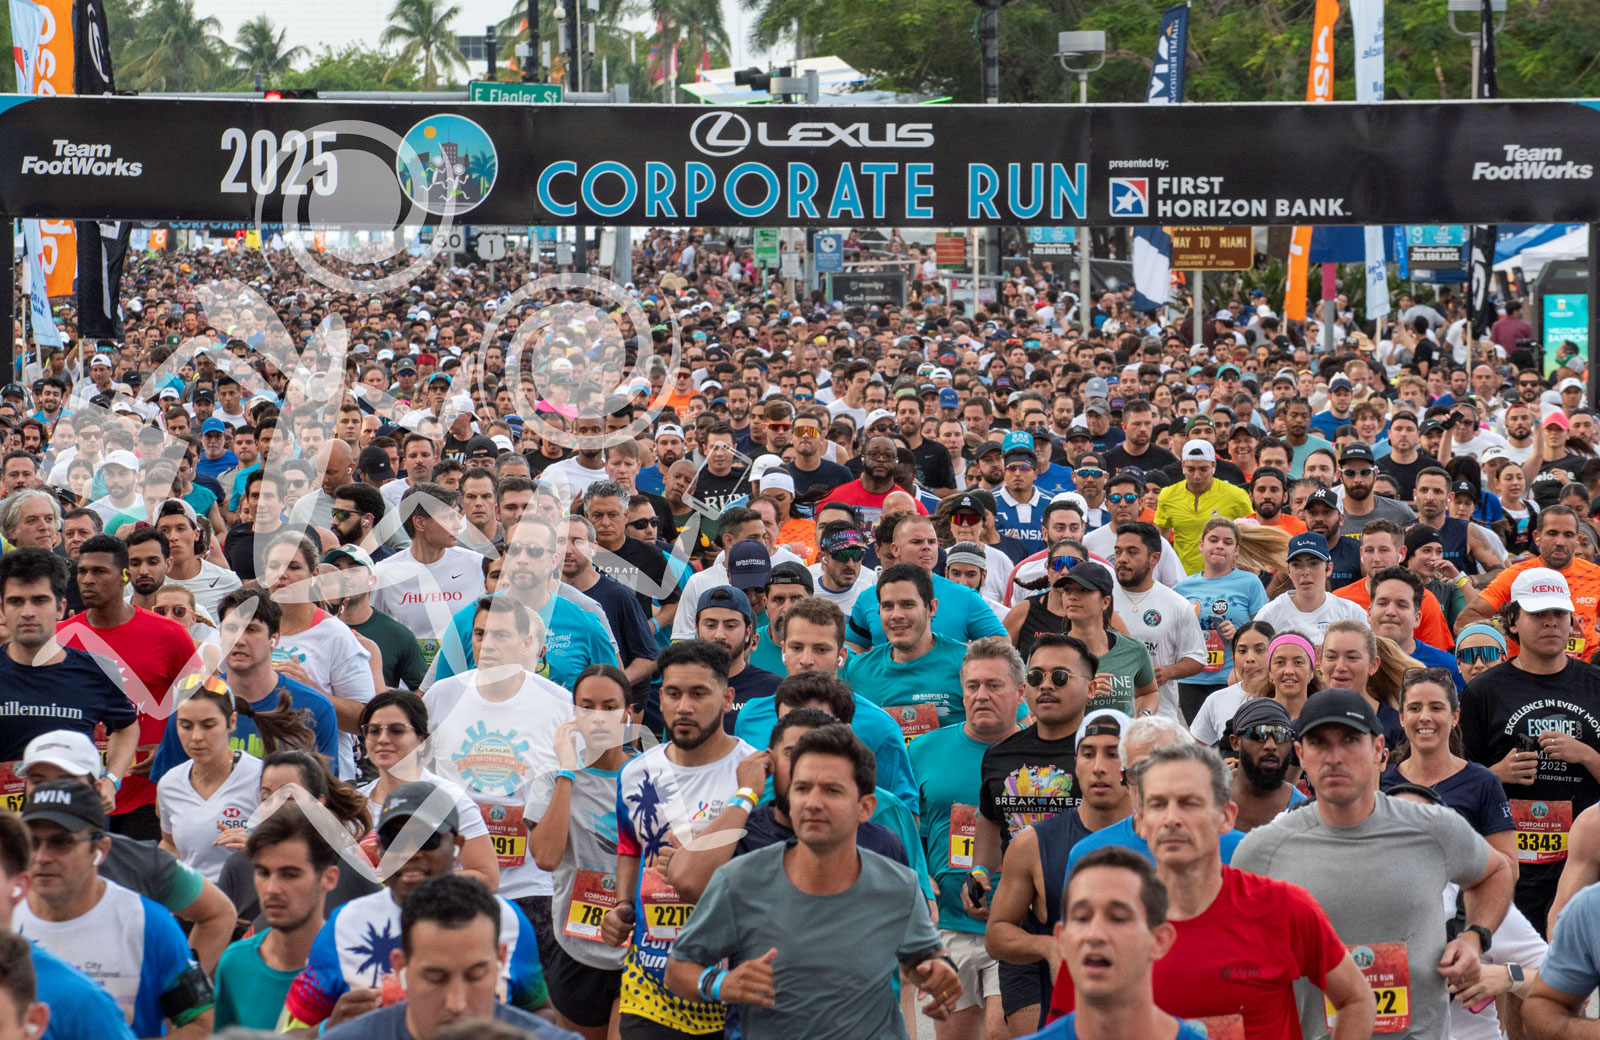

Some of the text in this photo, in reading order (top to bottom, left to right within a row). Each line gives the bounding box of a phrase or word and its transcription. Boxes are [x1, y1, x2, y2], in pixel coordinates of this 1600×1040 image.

[475, 88, 558, 103] E Flagler St
[757, 122, 935, 148] LEXUS
[52, 139, 111, 158] Team
[1503, 144, 1563, 162] Team
[21, 155, 143, 177] FootWorks
[220, 127, 339, 197] 2025
[1109, 159, 1169, 170] presented by:
[1472, 161, 1594, 181] FootWorks
[536, 159, 1089, 220] CORPORATE RUN
[1157, 176, 1224, 195] FIRST
[1157, 198, 1345, 218] HORIZON BANK
[436, 234, 460, 248] 30
[489, 240, 494, 255] 1
[1173, 236, 1247, 248] WAY TO MIAMI
[1532, 584, 1564, 594] KENYA
[397, 591, 462, 606] SHISEIDO
[1213, 602, 1226, 611] 305
[1504, 700, 1544, 736] EXCELLENCE
[1545, 699, 1556, 708] IN
[1557, 700, 1586, 716] EVERY
[1528, 718, 1576, 738] ESSENCE
[468, 756, 502, 764] CORPORATE
[1541, 761, 1568, 772] 2025
[34, 790, 72, 805] WIN
[712, 800, 724, 808] City
[995, 796, 1083, 806] BREAKWATER
[1518, 833, 1562, 851] 3343
[582, 904, 612, 926] 78
[638, 950, 668, 969] Run
